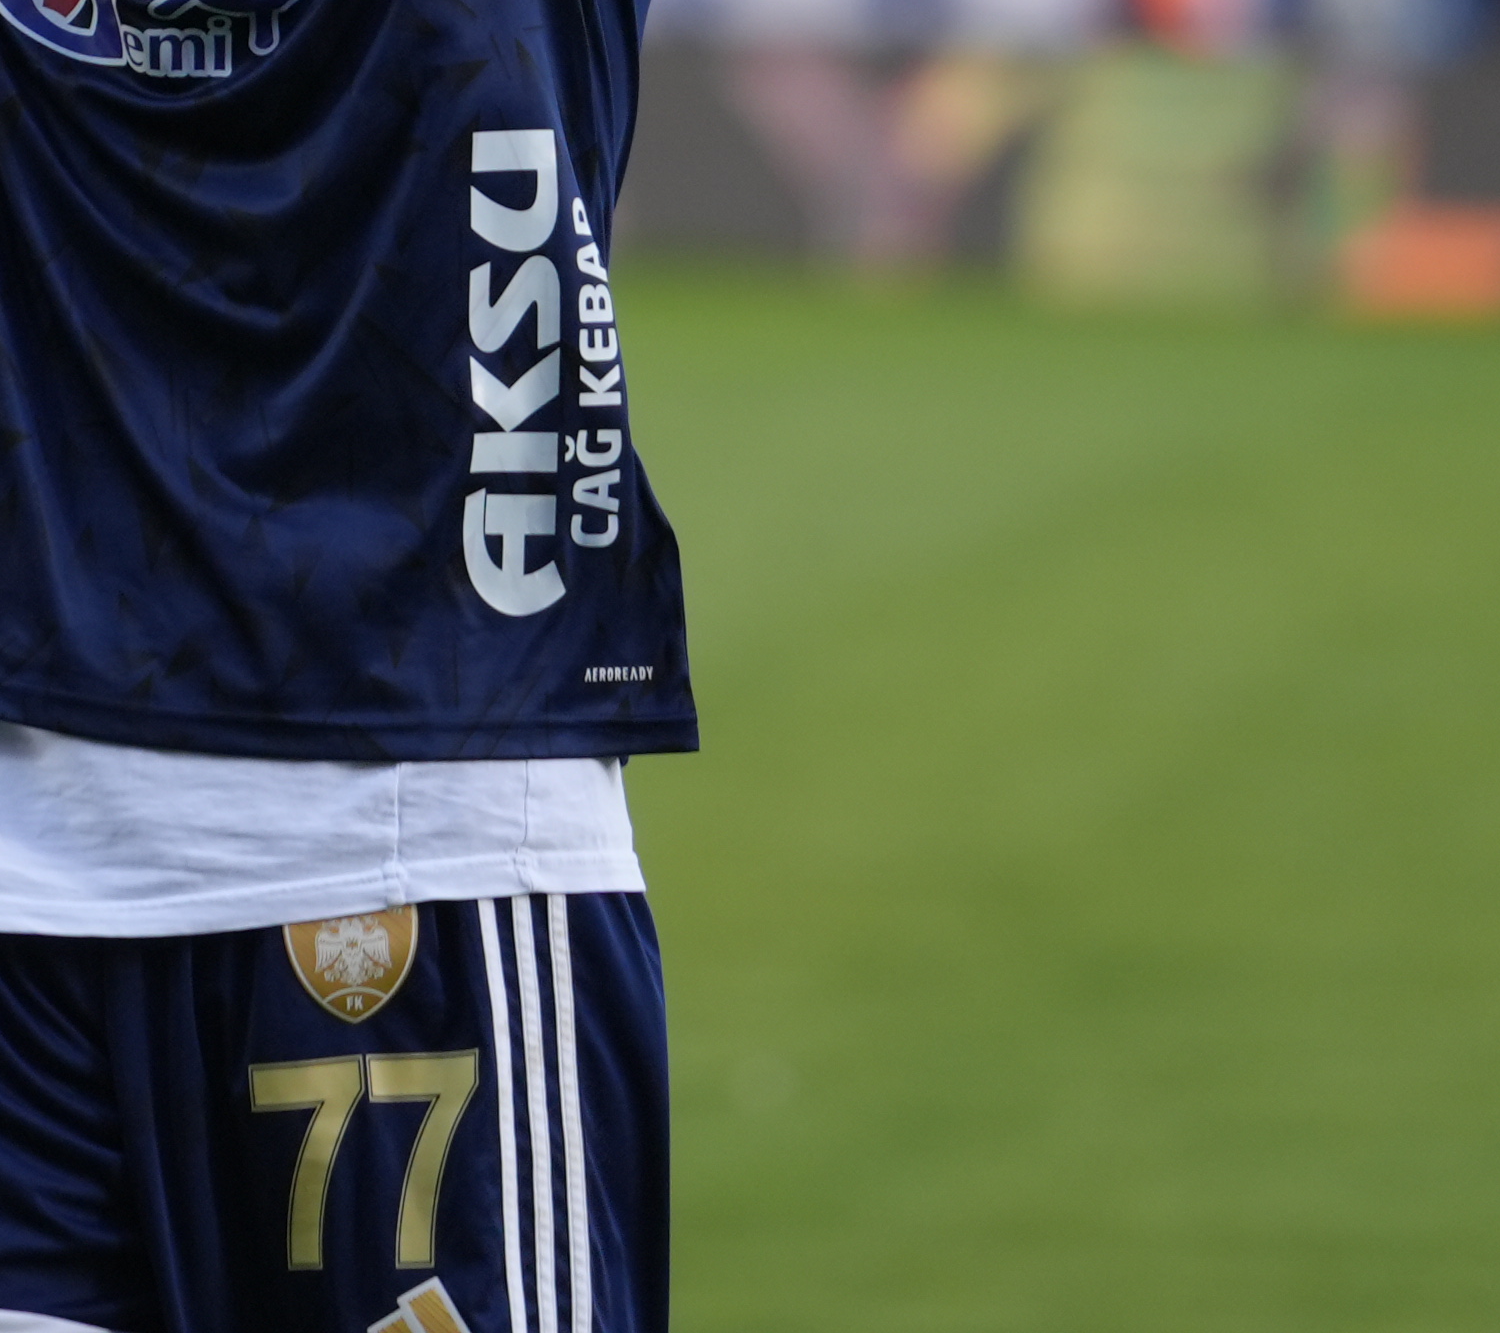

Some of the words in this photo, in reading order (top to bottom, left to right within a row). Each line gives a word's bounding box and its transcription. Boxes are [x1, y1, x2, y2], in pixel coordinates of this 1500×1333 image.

[463, 128, 567, 618] AKSU
[564, 428, 622, 549] CAĞ
[583, 665, 654, 683] AEROREADY
[345, 994, 364, 1012] FK
[248, 1047, 480, 1271] 77
